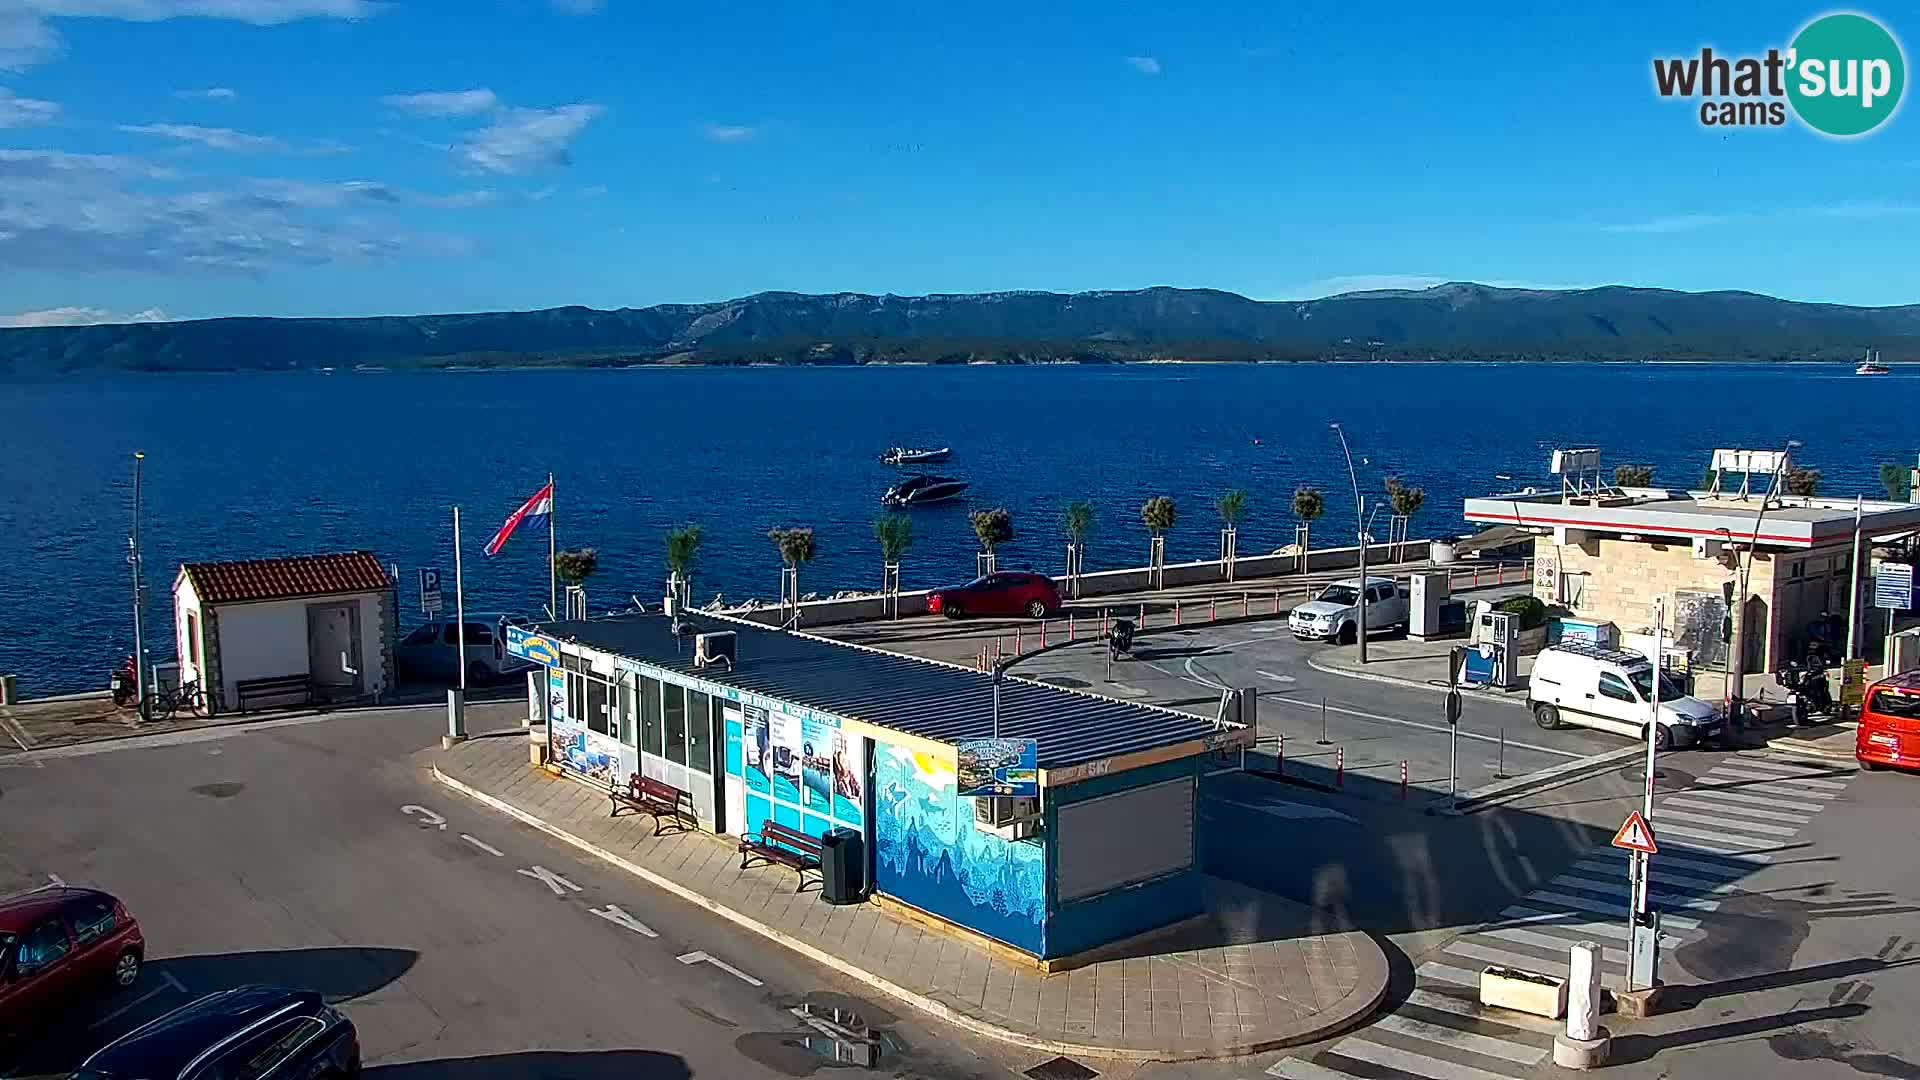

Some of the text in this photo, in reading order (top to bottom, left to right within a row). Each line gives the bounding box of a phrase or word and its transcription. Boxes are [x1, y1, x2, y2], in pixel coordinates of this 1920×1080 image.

[426, 572, 437, 588] P
[753, 695, 784, 711] STATION
[786, 704, 811, 720] TICKET
[811, 709, 837, 726] OFFICE
